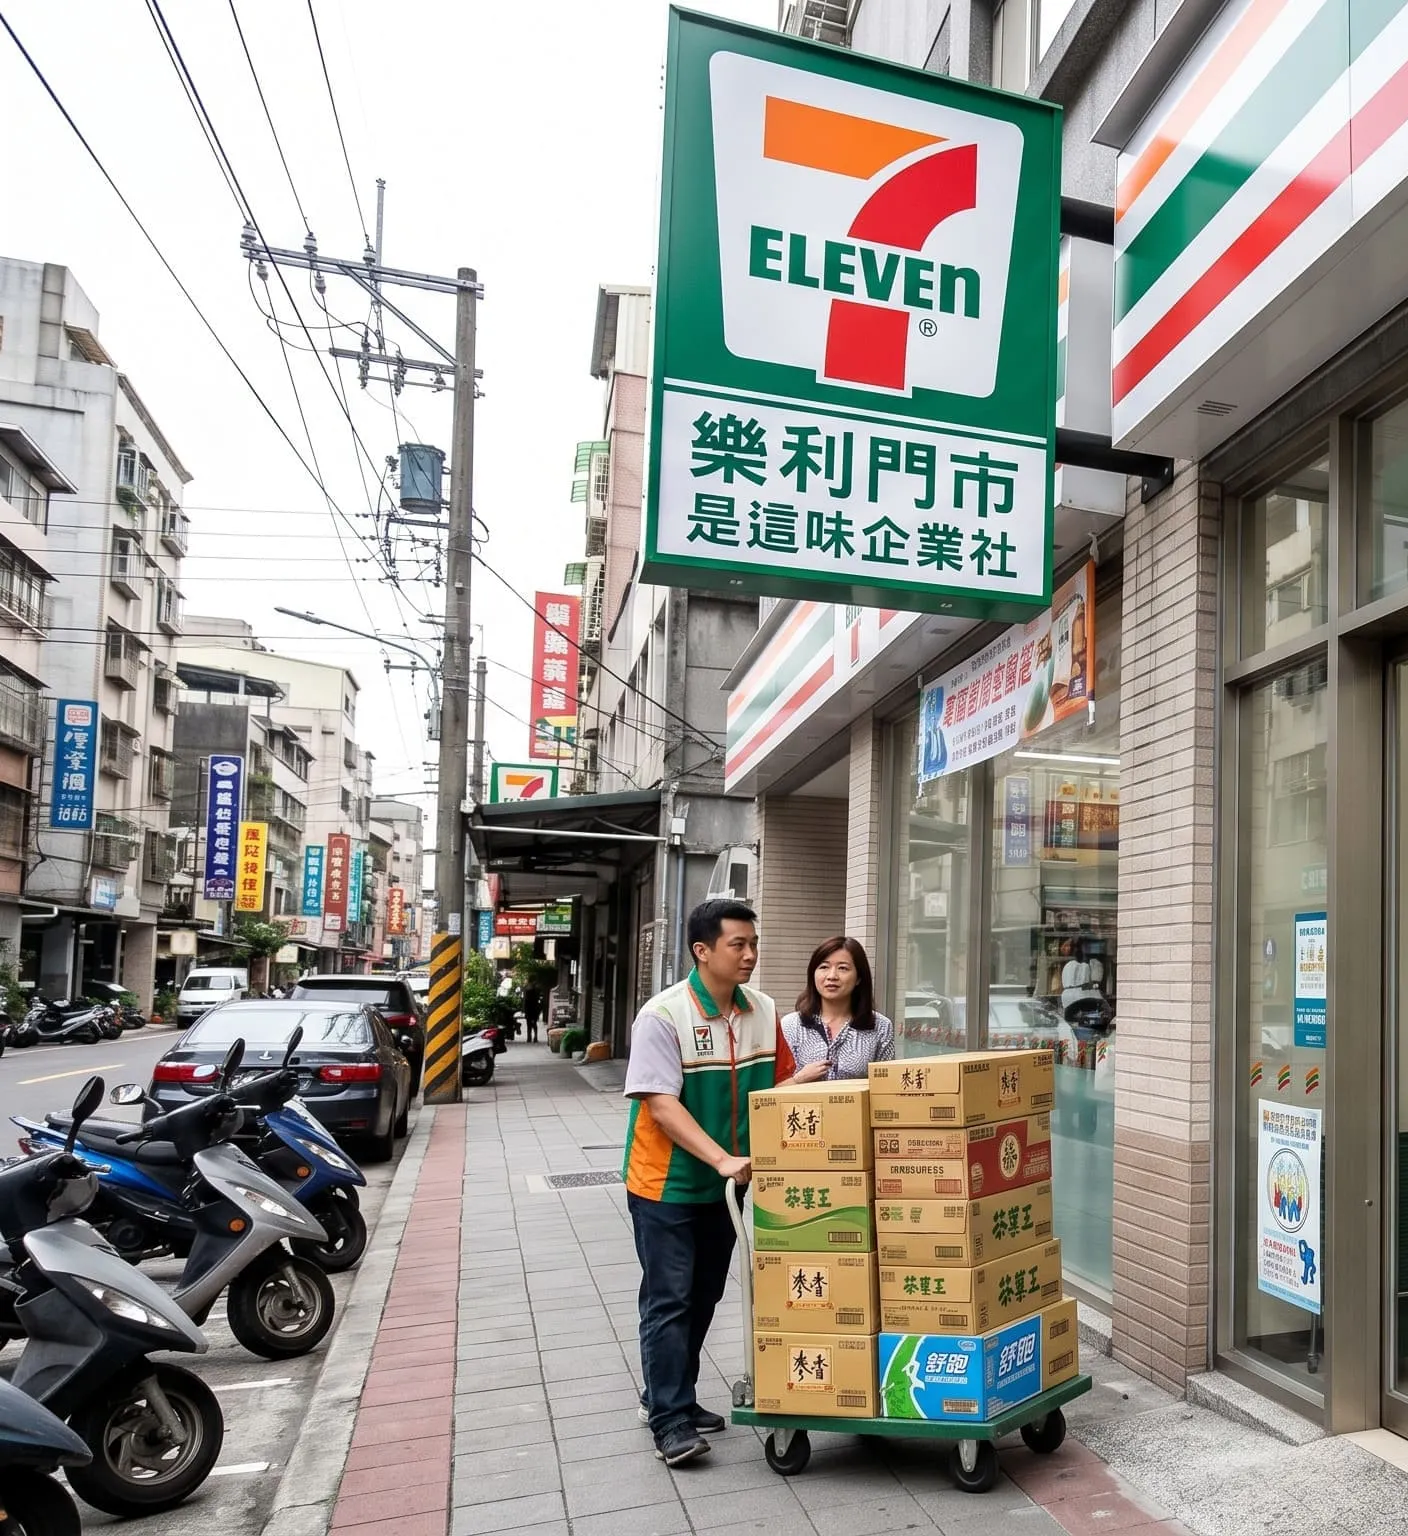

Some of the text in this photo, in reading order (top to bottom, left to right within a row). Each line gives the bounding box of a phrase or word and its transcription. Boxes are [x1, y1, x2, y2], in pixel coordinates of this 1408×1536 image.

[749, 95, 981, 390] 7 ELEVEn
[689, 410, 1018, 518] 樂利門市
[686, 492, 1018, 579] 是這味企業社
[925, 1352, 969, 1374] 舒跑
